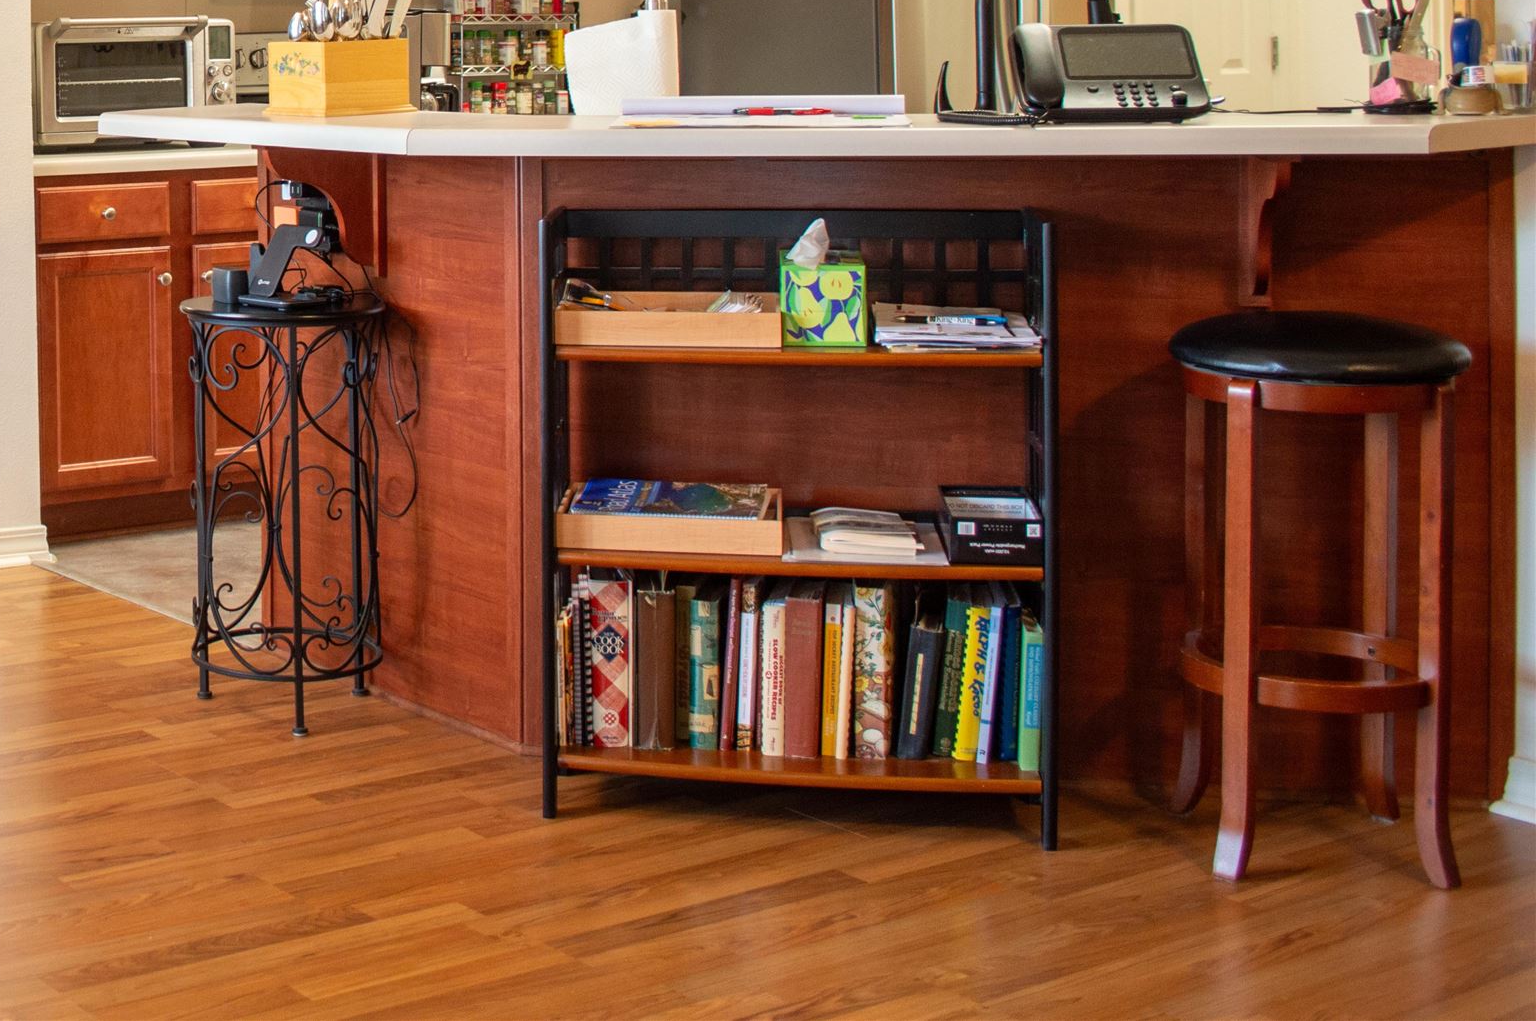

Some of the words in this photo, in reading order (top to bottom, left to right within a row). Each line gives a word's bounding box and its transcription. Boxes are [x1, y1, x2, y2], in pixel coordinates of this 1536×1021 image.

[594, 635, 624, 646] COOK
[975, 616, 991, 660] RALPH
[595, 644, 624, 655] BOOK
[974, 662, 985, 675] &
[770, 691, 778, 721] RECIPES
